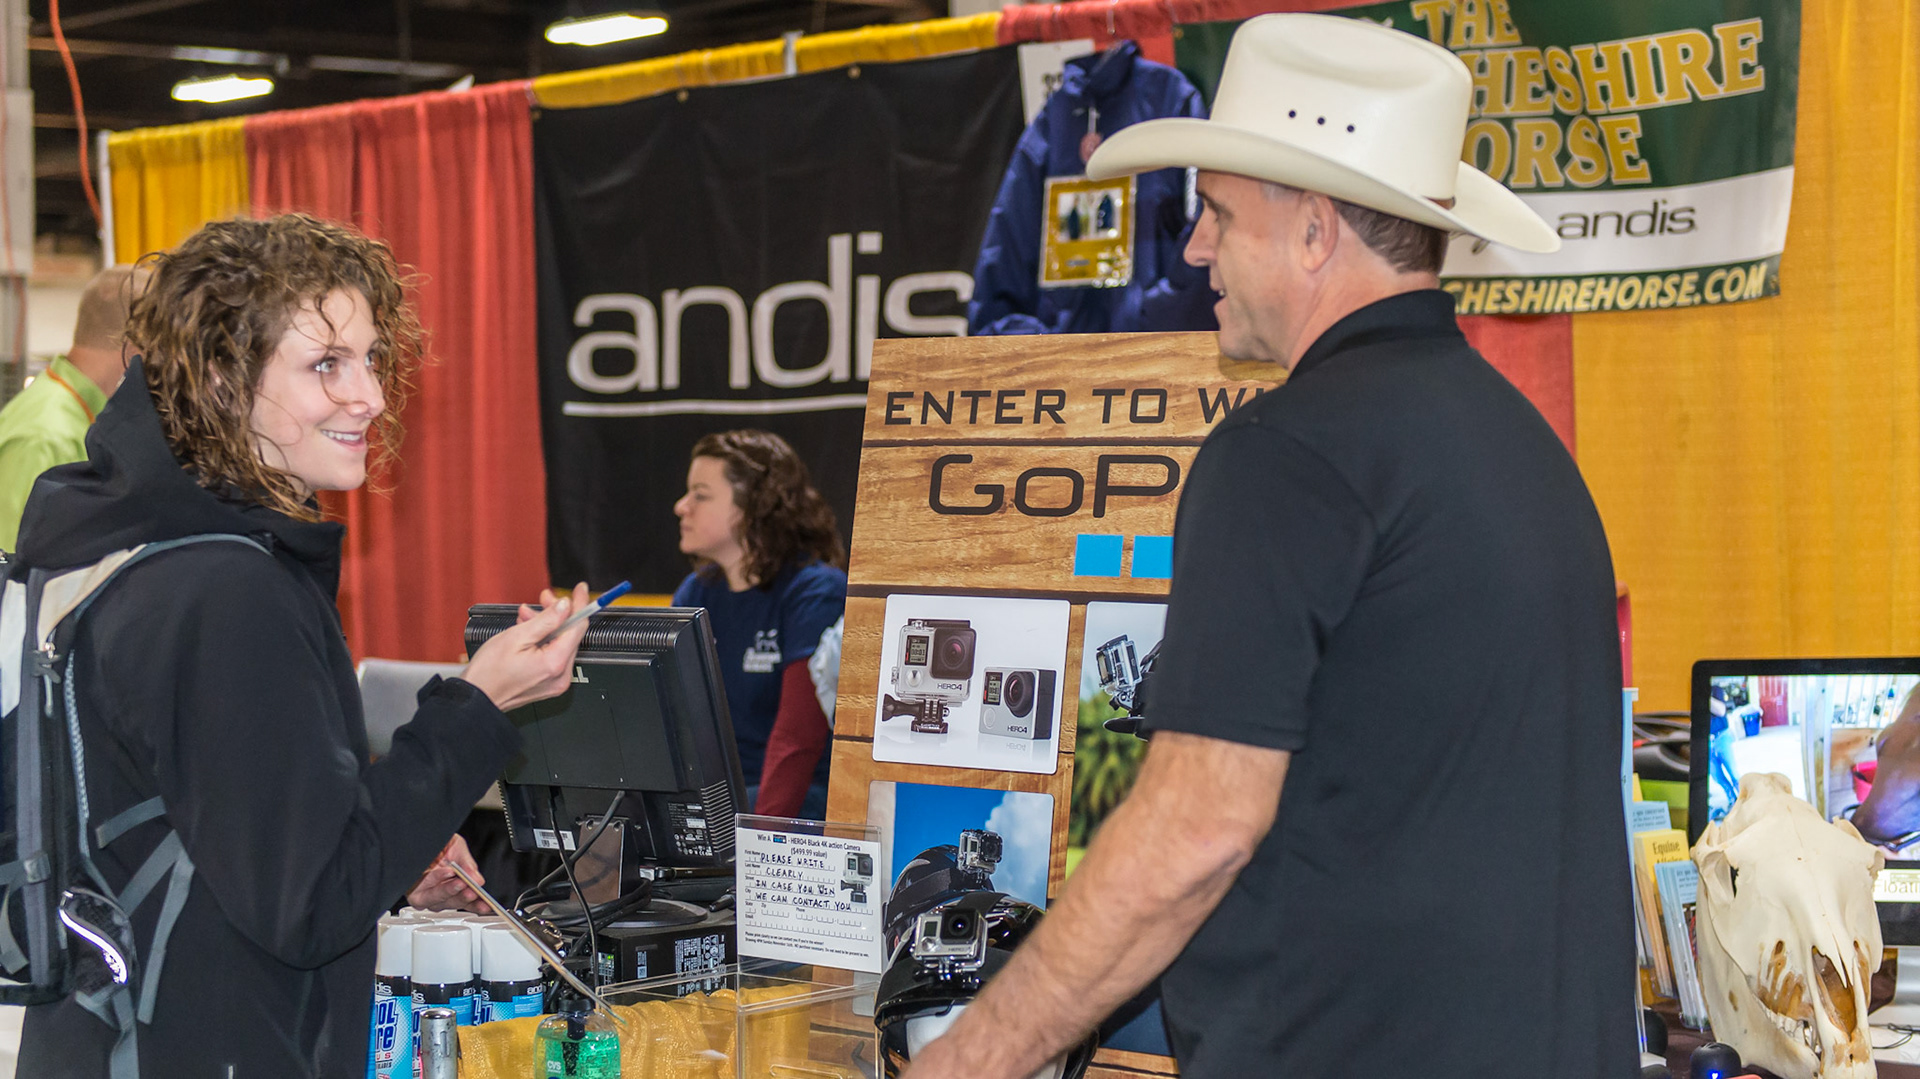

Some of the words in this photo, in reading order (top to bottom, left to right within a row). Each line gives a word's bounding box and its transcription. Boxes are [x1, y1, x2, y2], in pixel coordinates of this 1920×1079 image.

[1411, 0, 1522, 49] THE
[1458, 17, 1765, 117] HESHIRE
[1463, 113, 1652, 189] ORSE
[1557, 199, 1697, 240] andis
[566, 231, 976, 394] andis
[884, 389, 1066, 425] ENTER
[1092, 388, 1168, 424] TO
[929, 454, 1180, 518] GoP
[937, 683, 962, 691] HERO4
[1007, 725, 1027, 734] HERO4
[790, 837, 807, 845] HERO4
[808, 839, 820, 847] Black
[844, 843, 861, 851] Camera
[790, 847, 812, 856] ($499.99
[761, 853, 792, 865] PLEASE
[797, 858, 824, 868] WRITE
[766, 867, 803, 880] CLEARLY
[756, 879, 767, 887] IN
[771, 881, 793, 892] CASE
[797, 883, 813, 894] YOU
[817, 884, 835, 895] WIN
[755, 892, 767, 900] WE
[771, 893, 787, 902] CAN
[792, 896, 830, 908] CONTACT
[835, 901, 851, 911] YOU
